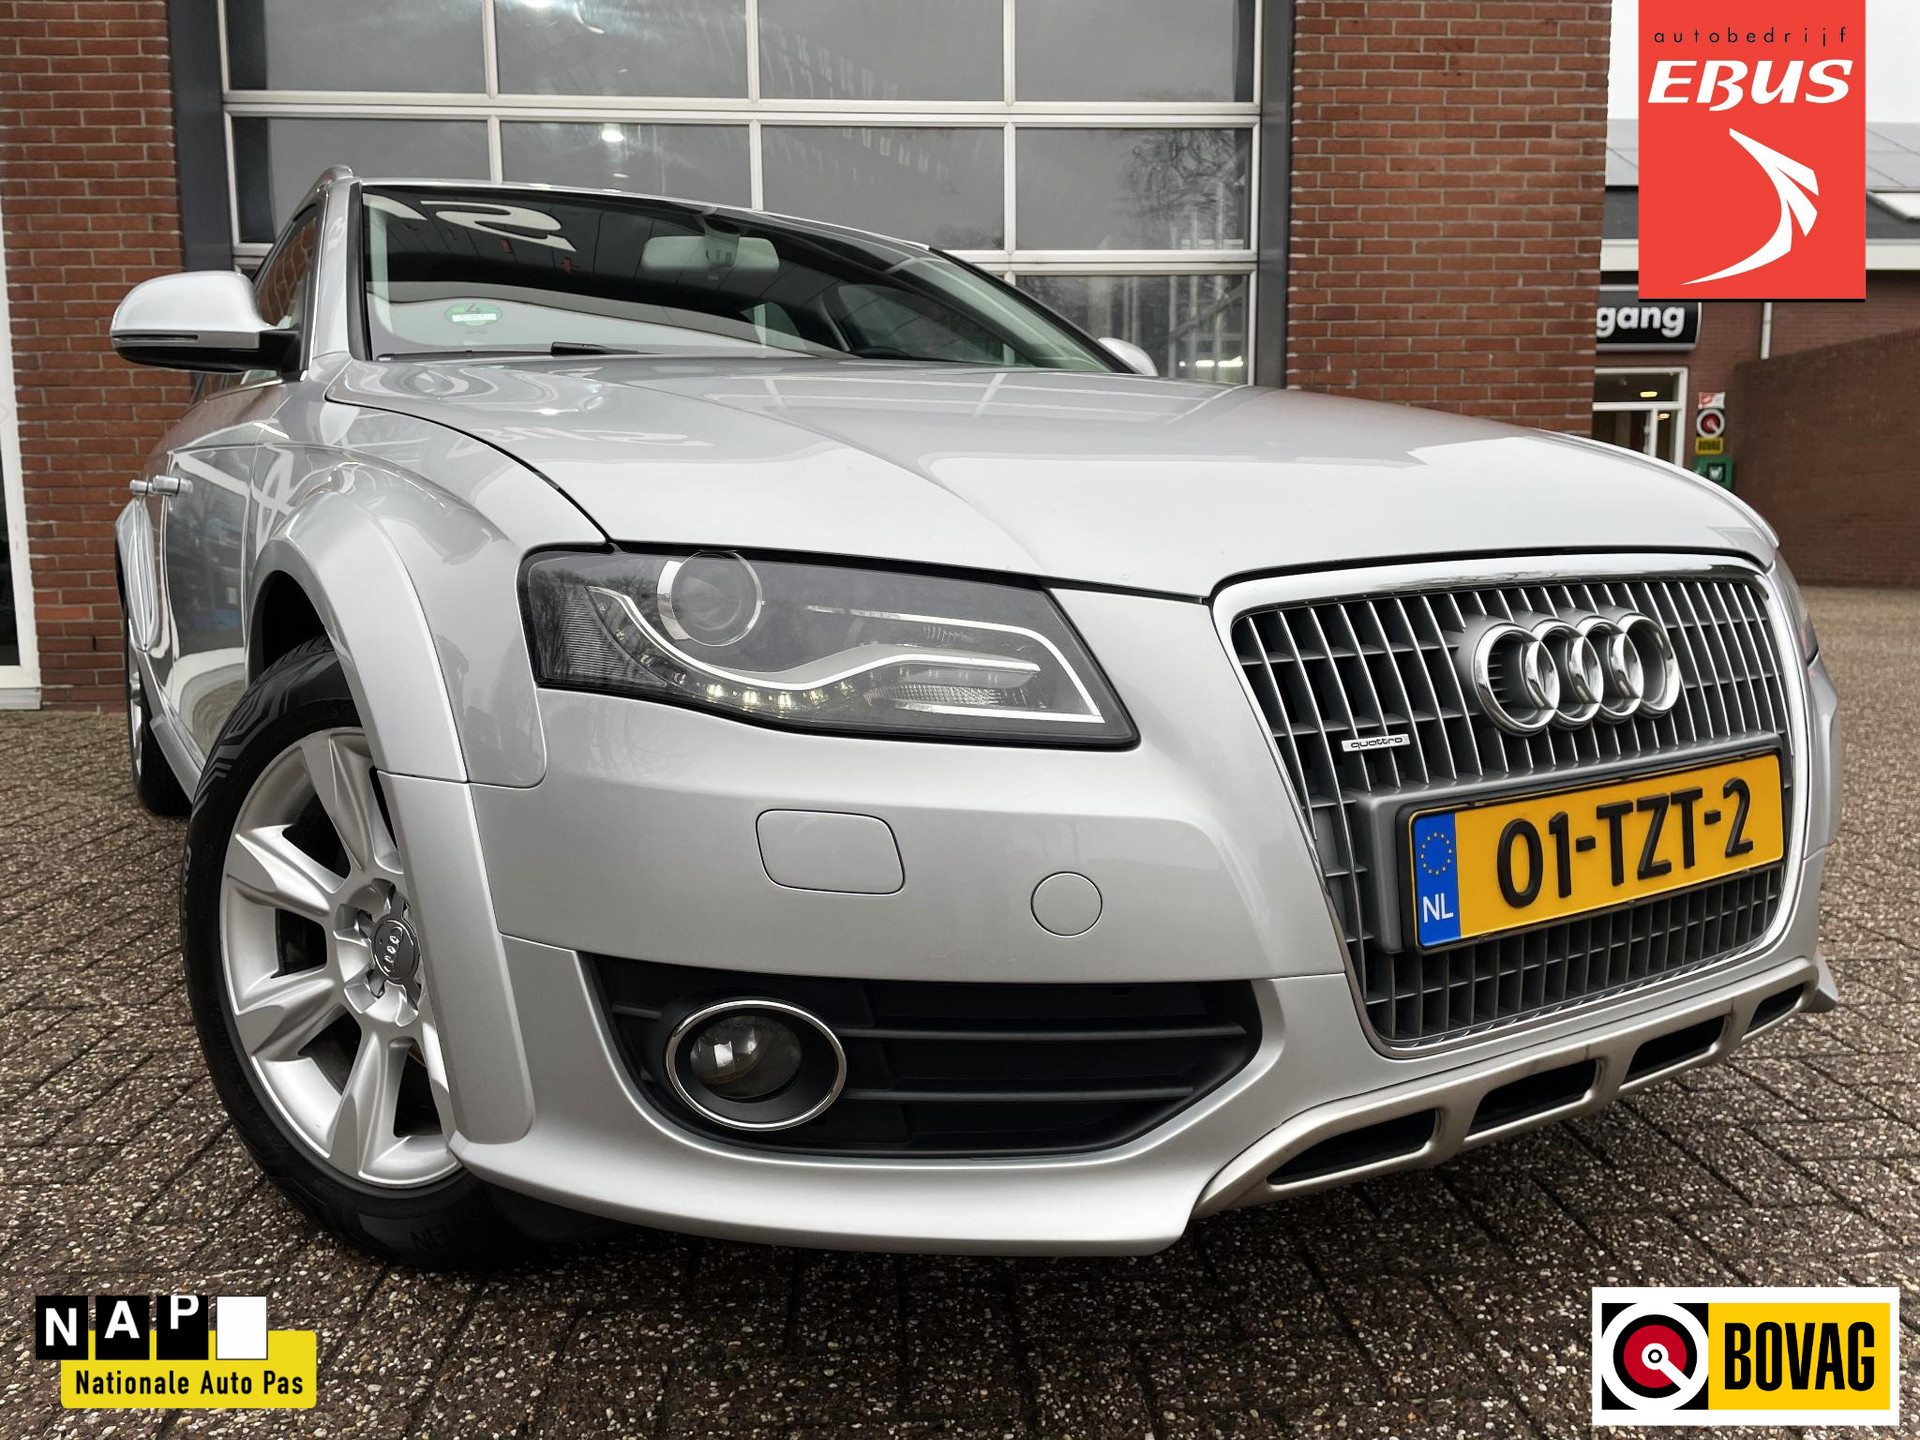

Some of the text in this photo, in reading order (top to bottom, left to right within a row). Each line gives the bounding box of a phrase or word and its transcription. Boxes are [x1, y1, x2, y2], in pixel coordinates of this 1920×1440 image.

[1596, 306, 1686, 338] gang
[1350, 737, 1403, 750] quattro
[1497, 778, 1754, 909] 01-TZT-2
[1422, 892, 1454, 923] NL
